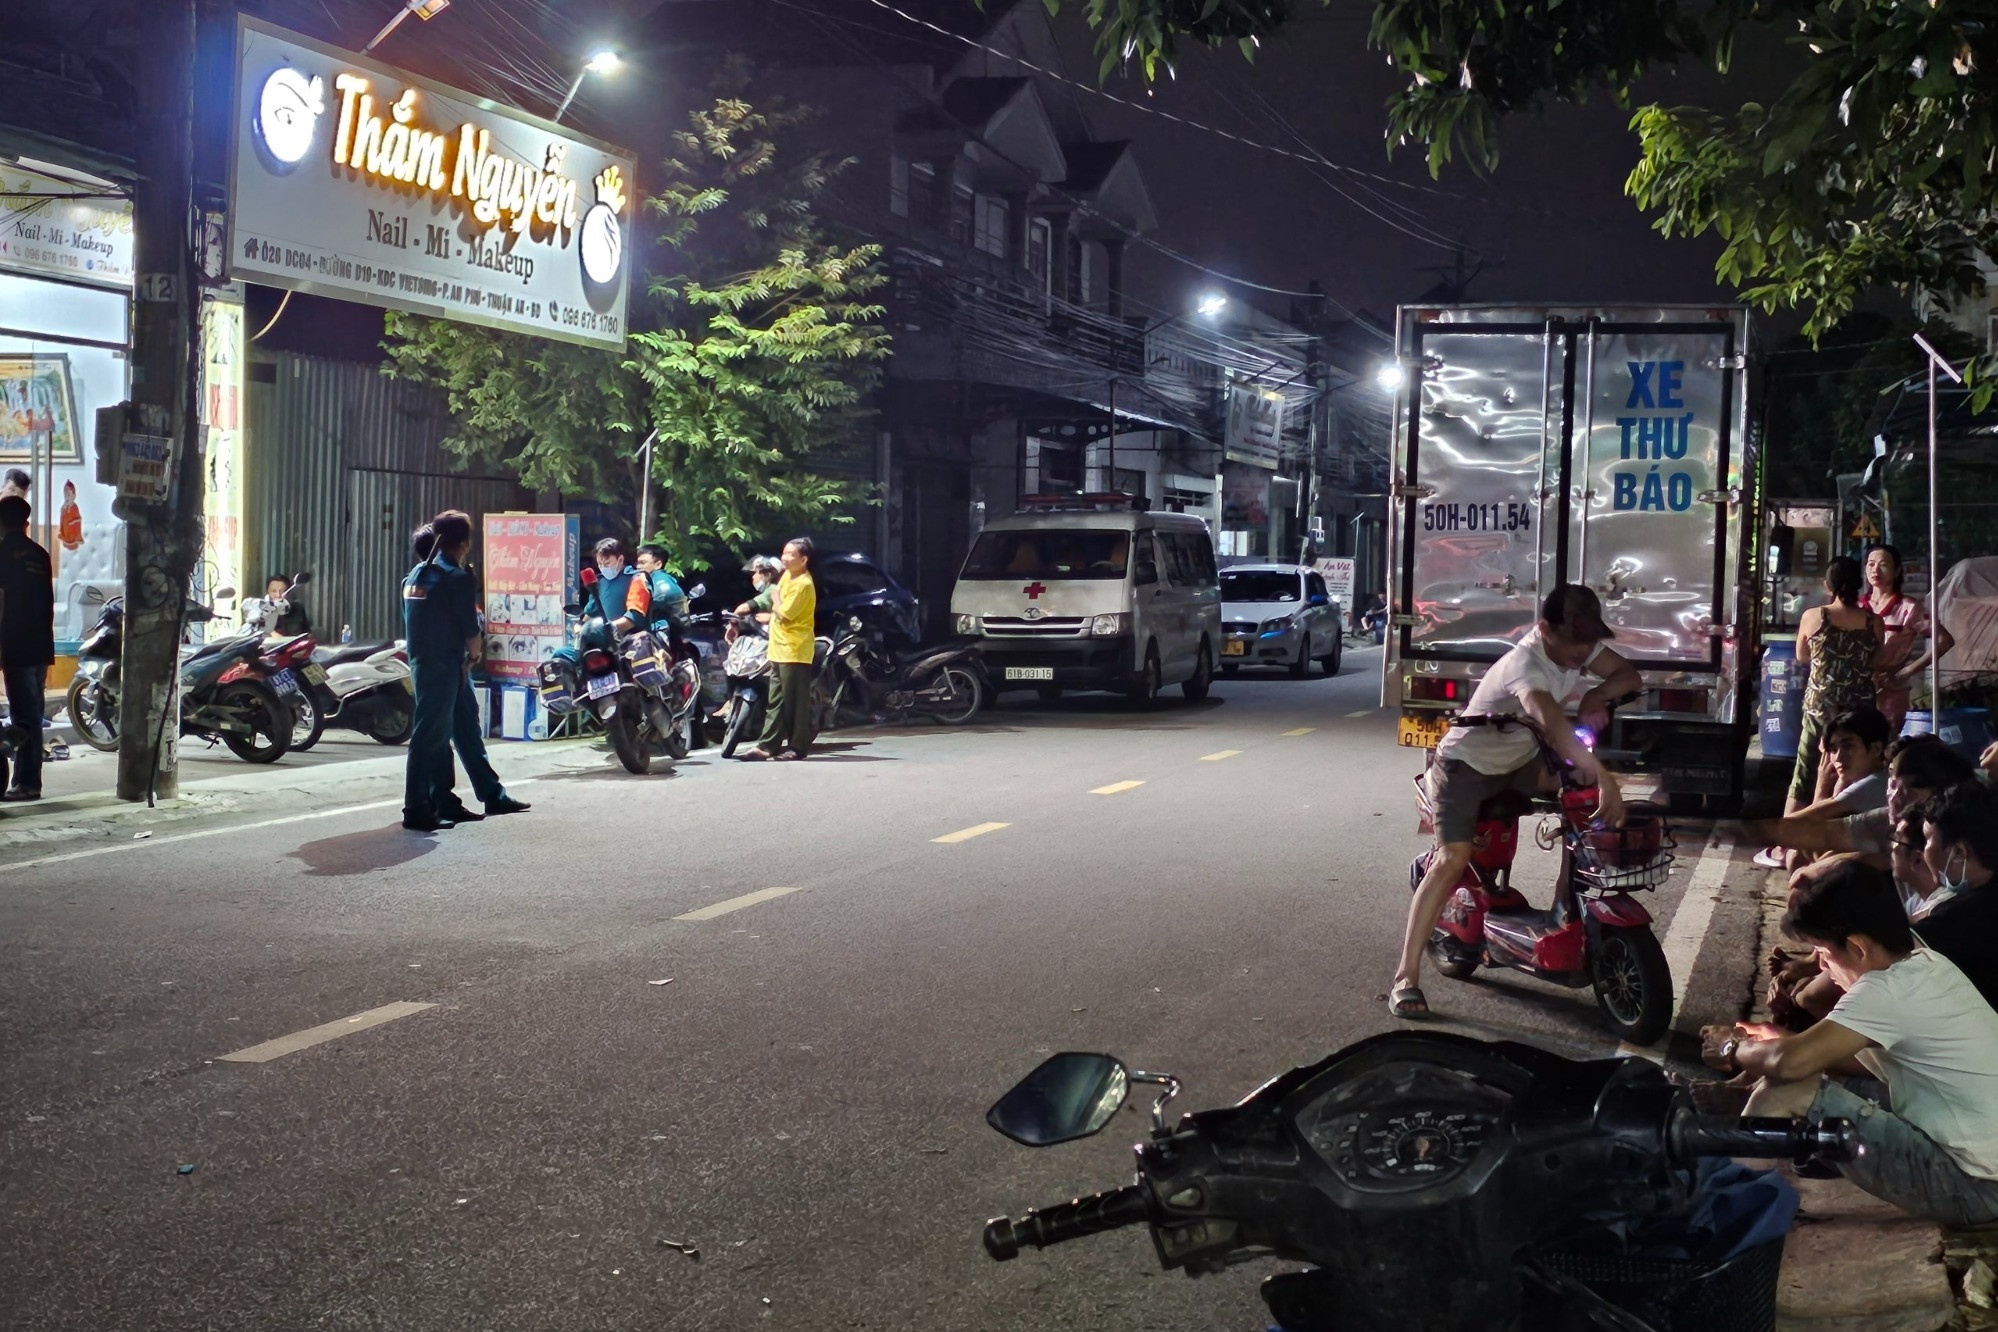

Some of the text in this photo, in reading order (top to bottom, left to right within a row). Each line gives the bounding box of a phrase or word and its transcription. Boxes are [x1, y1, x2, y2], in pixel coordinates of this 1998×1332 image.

[452, 122, 577, 233] Nguyễn
[14, 221, 41, 241] Nail
[49, 228, 63, 245] Mi
[71, 232, 114, 258] Makeup
[366, 209, 408, 249] Nail
[424, 224, 450, 260] Mi
[466, 234, 534, 285] Makeup
[144, 276, 173, 300] 12
[1625, 361, 1684, 409] XE
[1616, 412, 1694, 460] THƯ
[1613, 464, 1692, 512] BÁO
[1424, 503, 1530, 531] 50H-011.54
[567, 533, 577, 588] Makeup
[1404, 732, 1440, 747] 011.5
